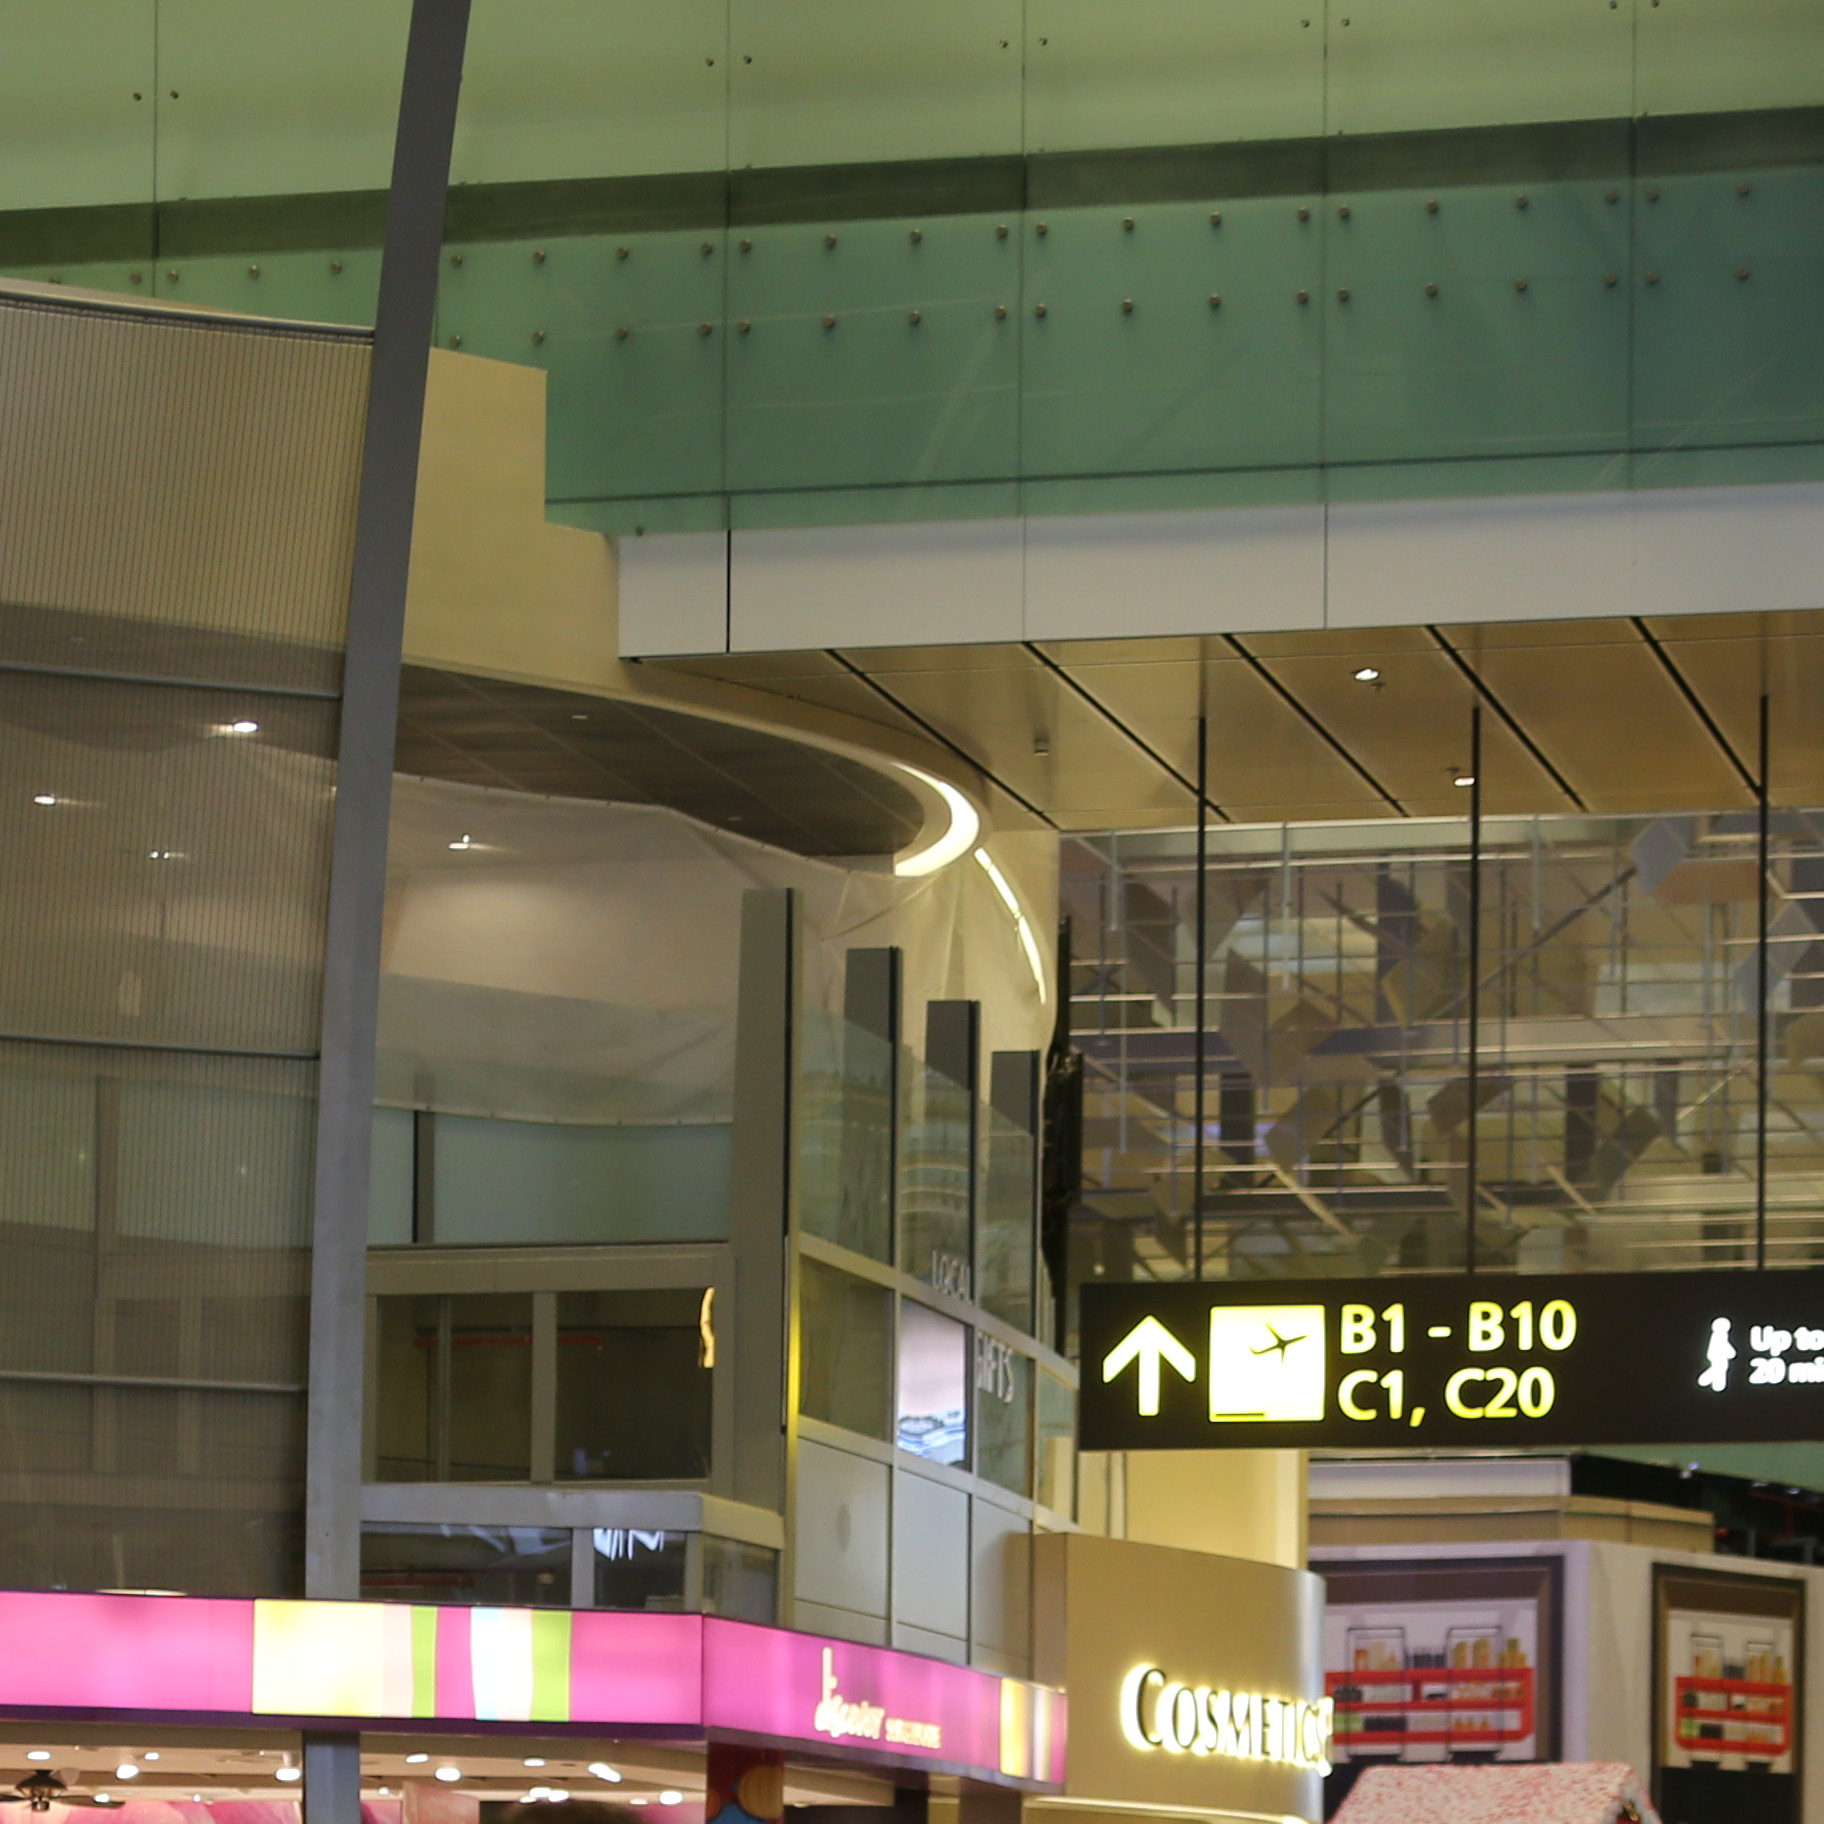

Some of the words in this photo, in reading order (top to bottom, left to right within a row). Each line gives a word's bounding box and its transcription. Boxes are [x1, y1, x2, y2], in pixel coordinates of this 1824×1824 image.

[1339, 1303, 1405, 1354] B1
[1427, 1326, 1452, 1338] -
[1468, 1300, 1577, 1351] B10
[1750, 1325, 1792, 1356] Up
[1749, 1357, 1786, 1384] 20
[1338, 1369, 1426, 1427] C1,
[1444, 1366, 1555, 1418] C20
